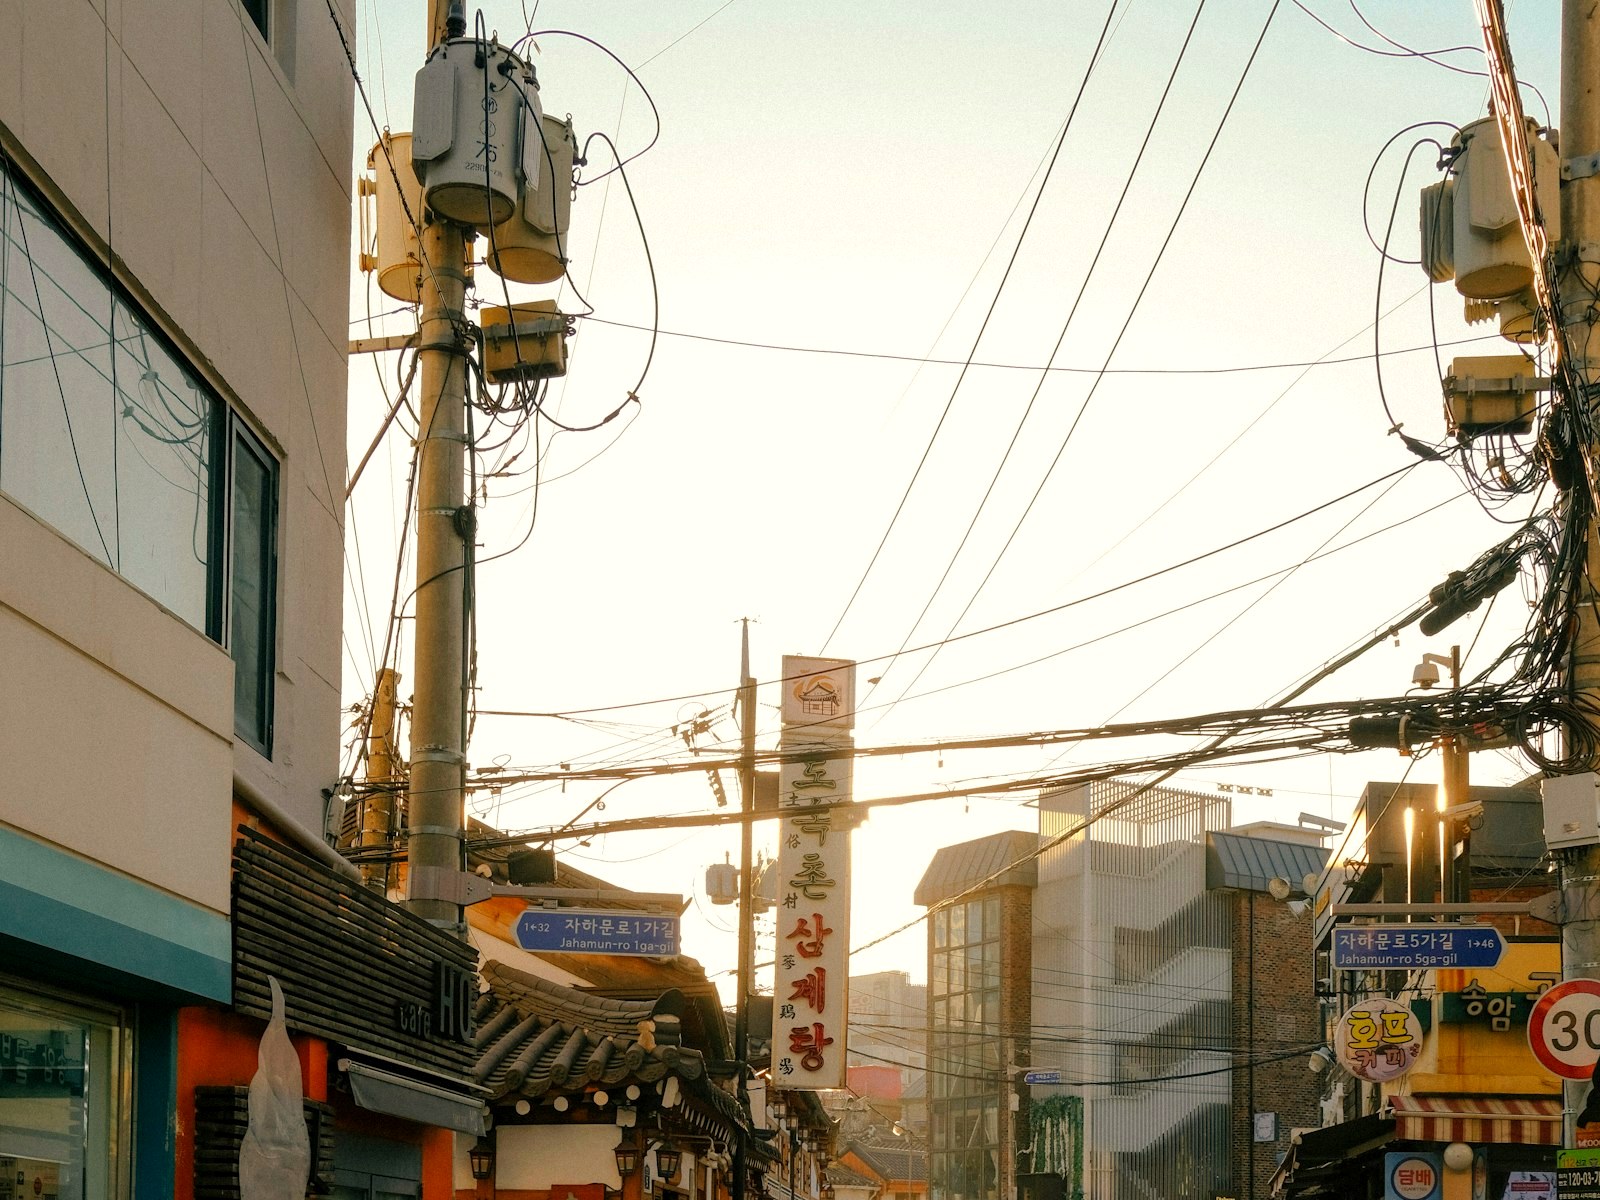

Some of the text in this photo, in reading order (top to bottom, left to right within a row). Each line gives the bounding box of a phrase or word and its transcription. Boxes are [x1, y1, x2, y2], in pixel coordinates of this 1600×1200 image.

[564, 917, 675, 939] 자하문로1가길
[559, 937, 675, 954] Jahamun-ro 1ga-gil
[1339, 932, 1453, 950] 자하문로5가길
[1339, 953, 1457, 966] Jahamun-ro 5ga-gil
[784, 912, 835, 1072] 삼계탕
[1347, 1010, 1414, 1049] 호프
[1551, 1009, 1600, 1052] 30
[1351, 1047, 1405, 1068] 커피
[1398, 1169, 1431, 1186] 담배
